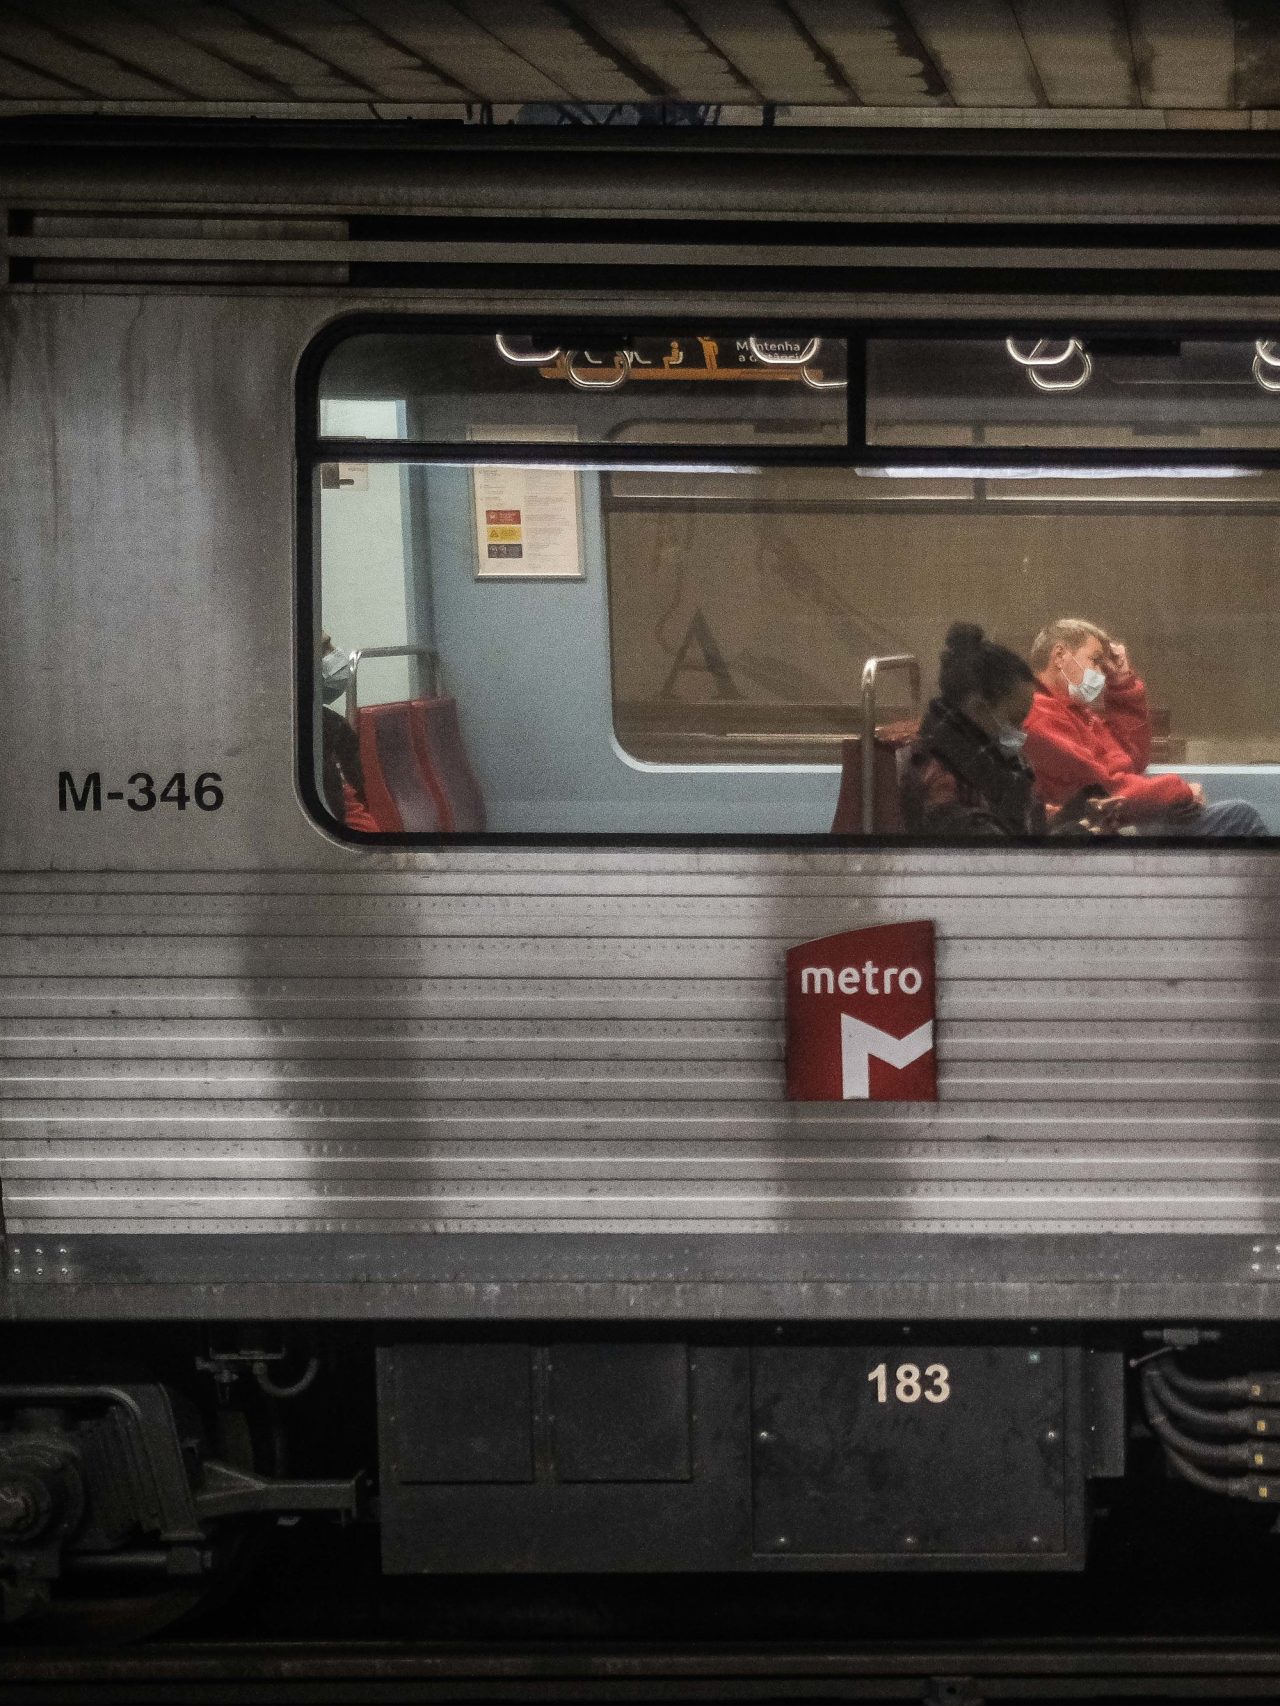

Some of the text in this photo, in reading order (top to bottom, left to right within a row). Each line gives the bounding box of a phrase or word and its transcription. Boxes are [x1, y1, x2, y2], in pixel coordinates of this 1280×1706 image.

[735, 340, 801, 352] Mntenha
[57, 770, 225, 812] M-346
[801, 960, 923, 995] metro
[867, 1362, 951, 1403] 183
